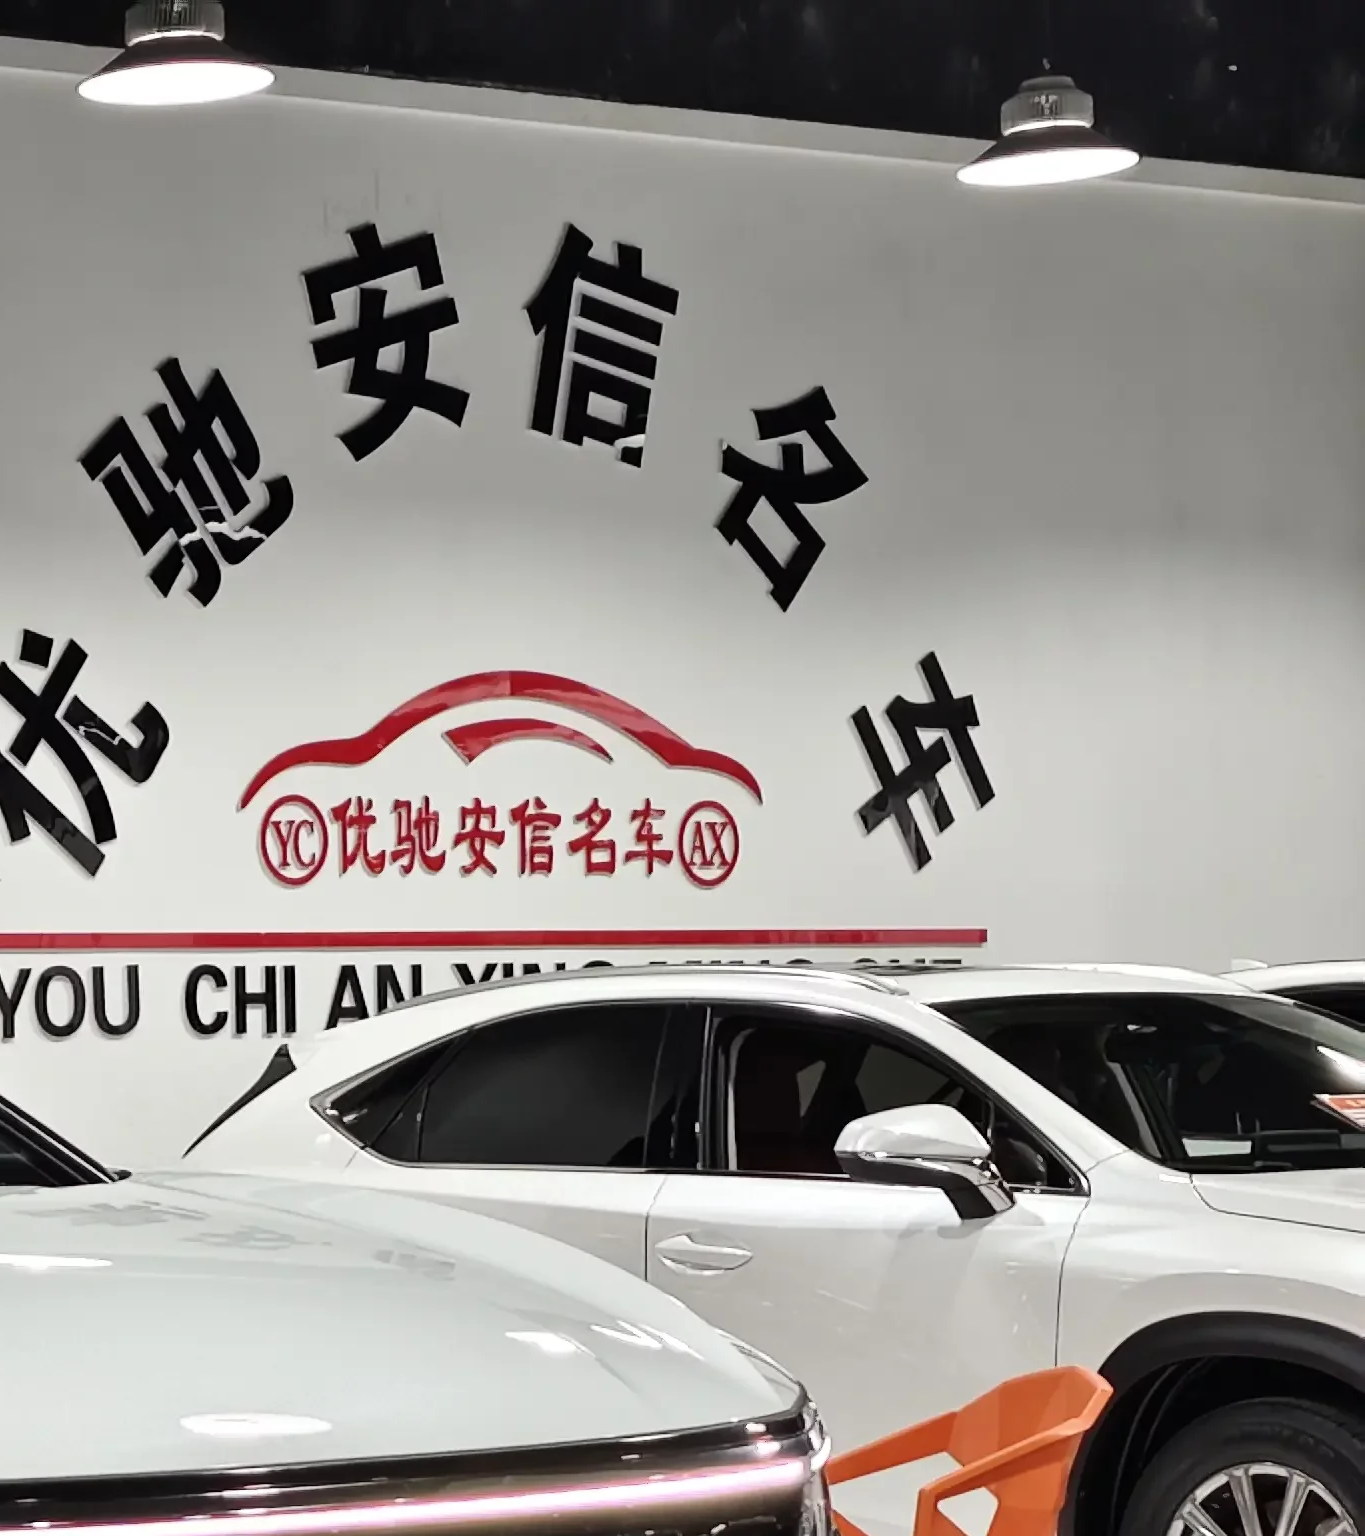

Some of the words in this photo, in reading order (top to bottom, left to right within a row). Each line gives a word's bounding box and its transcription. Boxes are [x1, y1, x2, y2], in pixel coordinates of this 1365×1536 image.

[331, 795, 675, 878] 优驰安信名车
[183, 963, 299, 1035] CHI
[327, 962, 425, 1028] AN
